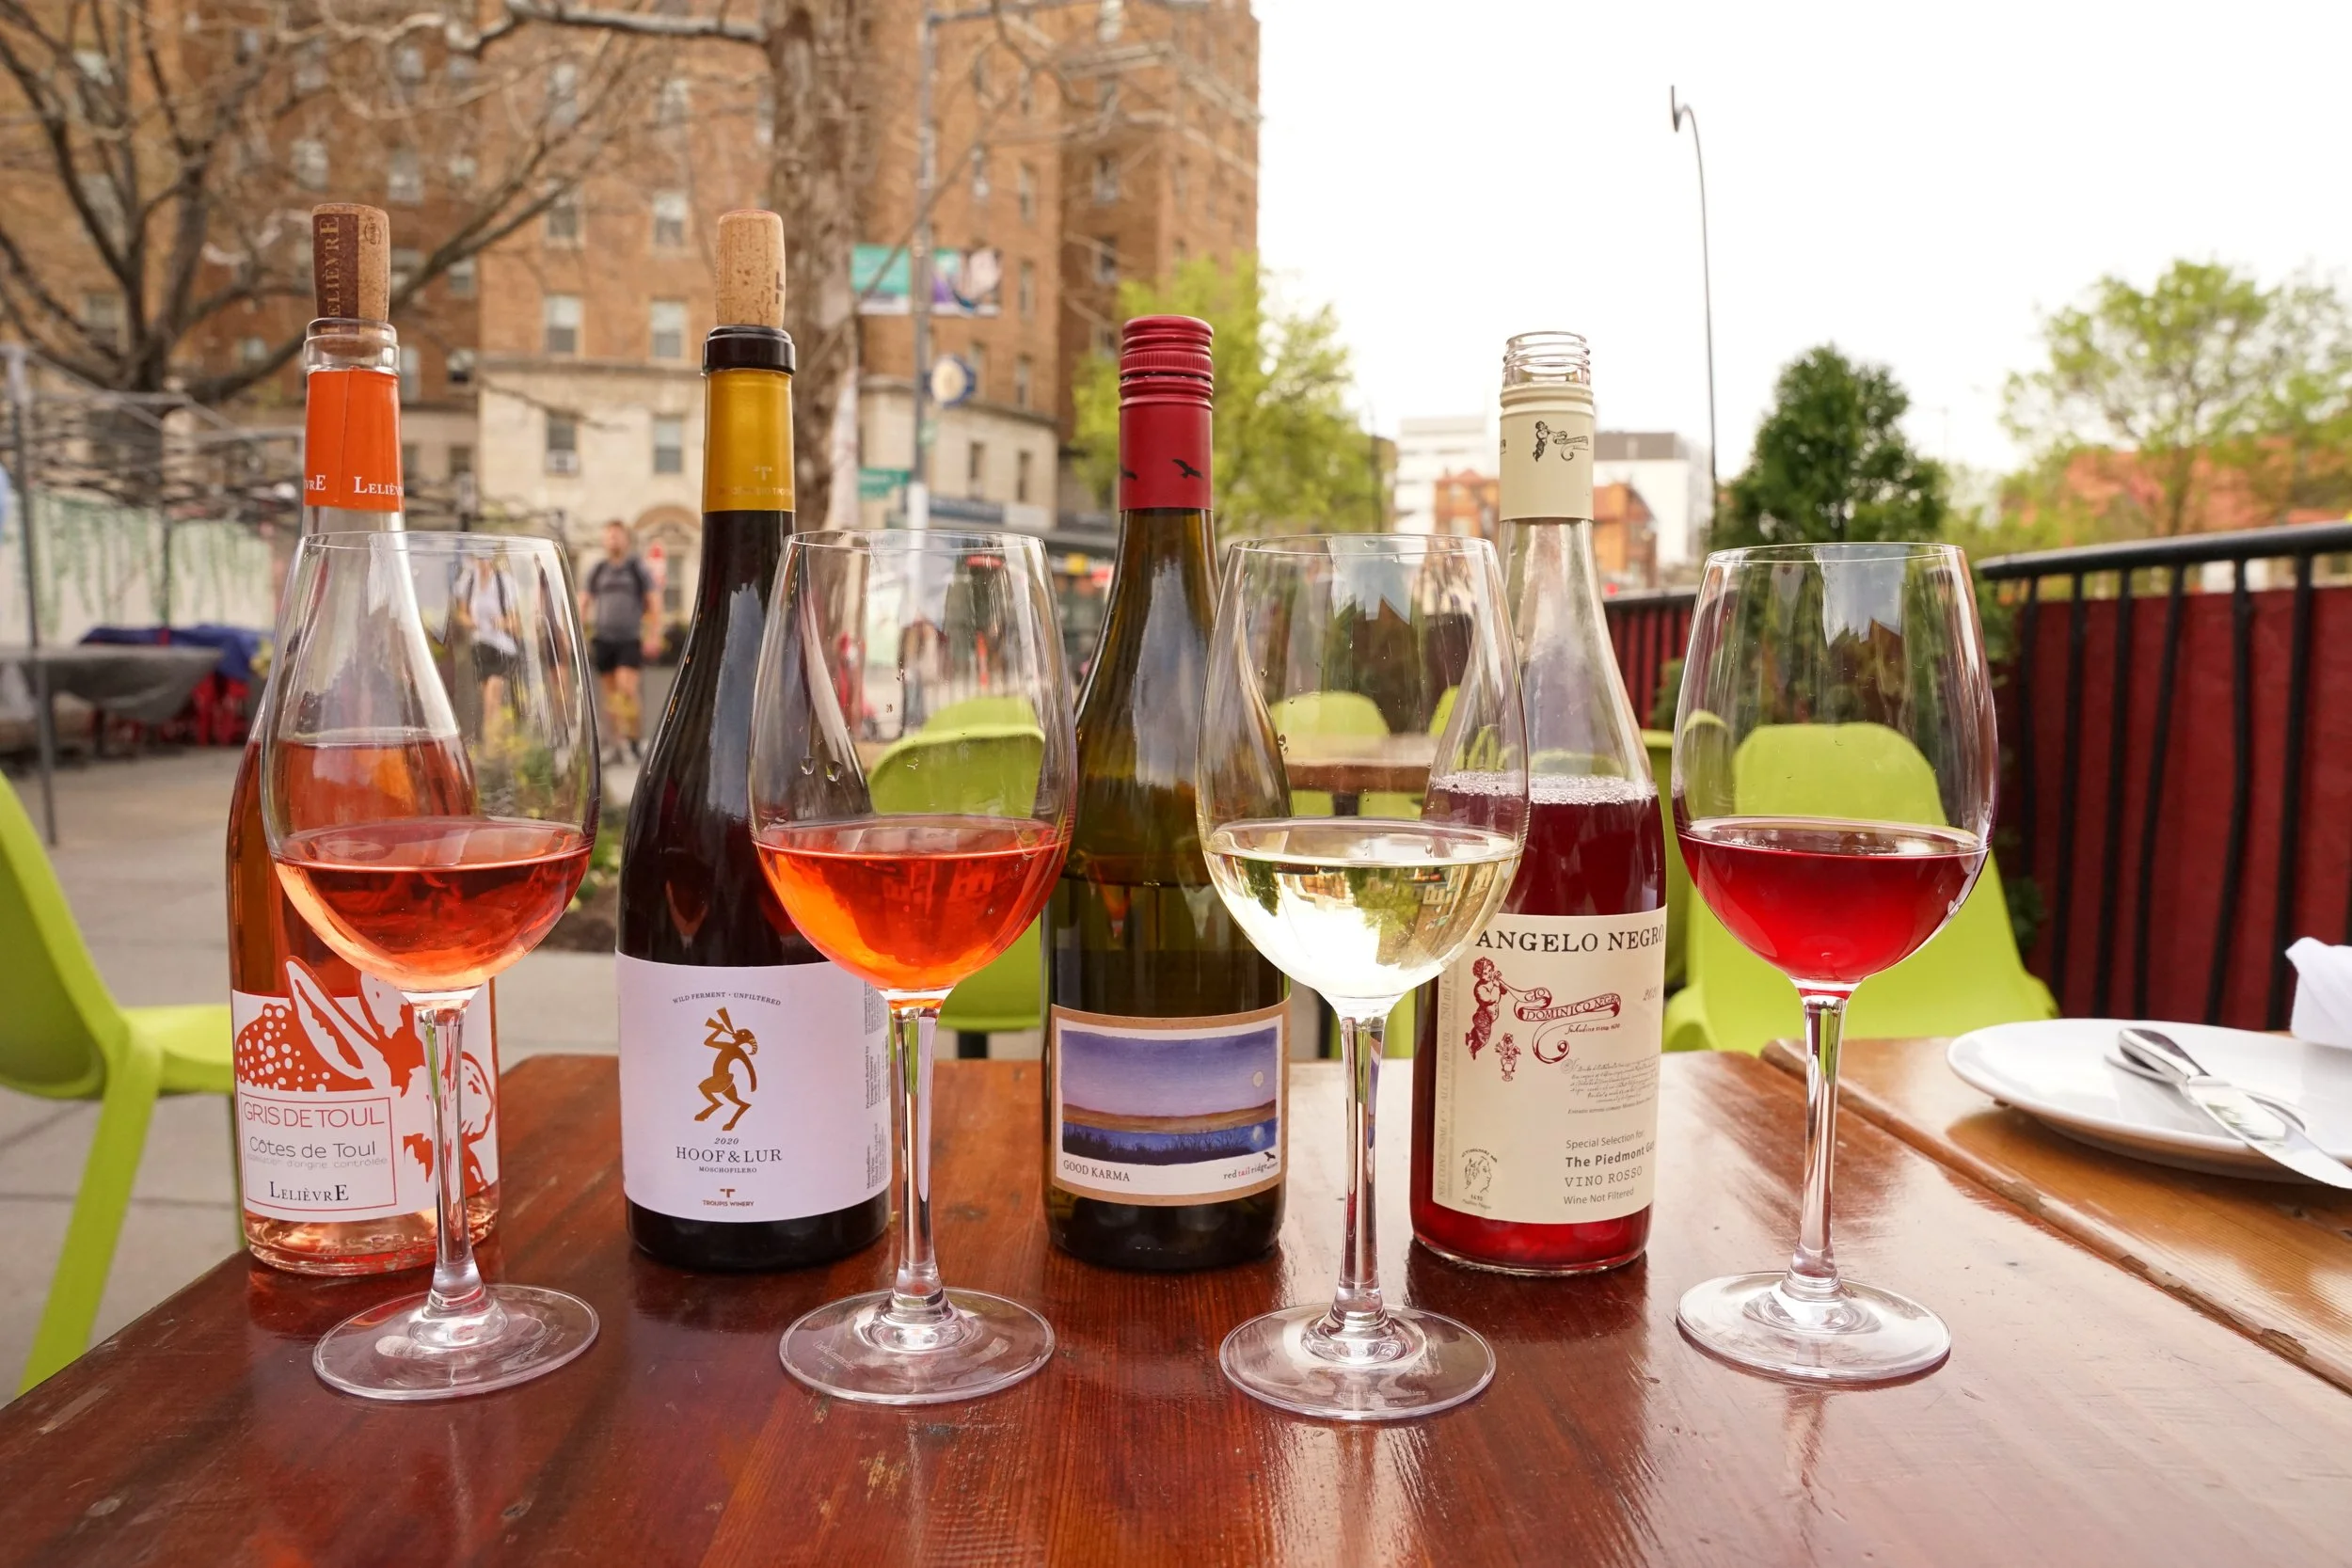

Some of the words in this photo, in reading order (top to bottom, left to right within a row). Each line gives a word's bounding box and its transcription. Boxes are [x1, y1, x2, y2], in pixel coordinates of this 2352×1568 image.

[354, 476, 404, 496] LELIÈV
[1475, 929, 1598, 952] ANGELO
[1608, 924, 1664, 951] NEGRO
[673, 995, 690, 1004] WILD
[691, 991, 726, 1000] FERMENT
[734, 992, 781, 1006] UNFILTERED
[1527, 1003, 1591, 1021] DOMINICO
[244, 1101, 281, 1126] GRIS
[284, 1108, 313, 1128] DE
[315, 1107, 385, 1128] TOUL
[249, 1136, 296, 1158] Côtes
[301, 1144, 326, 1158] de
[333, 1141, 375, 1158] Toul
[1565, 1138, 1599, 1150] Special
[1601, 1132, 1634, 1147] Selection
[675, 1146, 725, 1163] HOOF
[744, 1148, 783, 1163] LUR
[1565, 1156, 1591, 1167] The
[1595, 1147, 1645, 1165] Piedmont
[699, 1165, 757, 1174] MOSCHOFILERO
[1063, 1159, 1089, 1175] GOOD
[1091, 1167, 1131, 1181] KARMA
[1565, 1175, 1603, 1187] VINO
[1608, 1165, 1643, 1183] ROSSO
[1564, 1196, 1588, 1205] Wine
[1590, 1194, 1606, 1203] Not
[1607, 1186, 1634, 1200] Filtered
